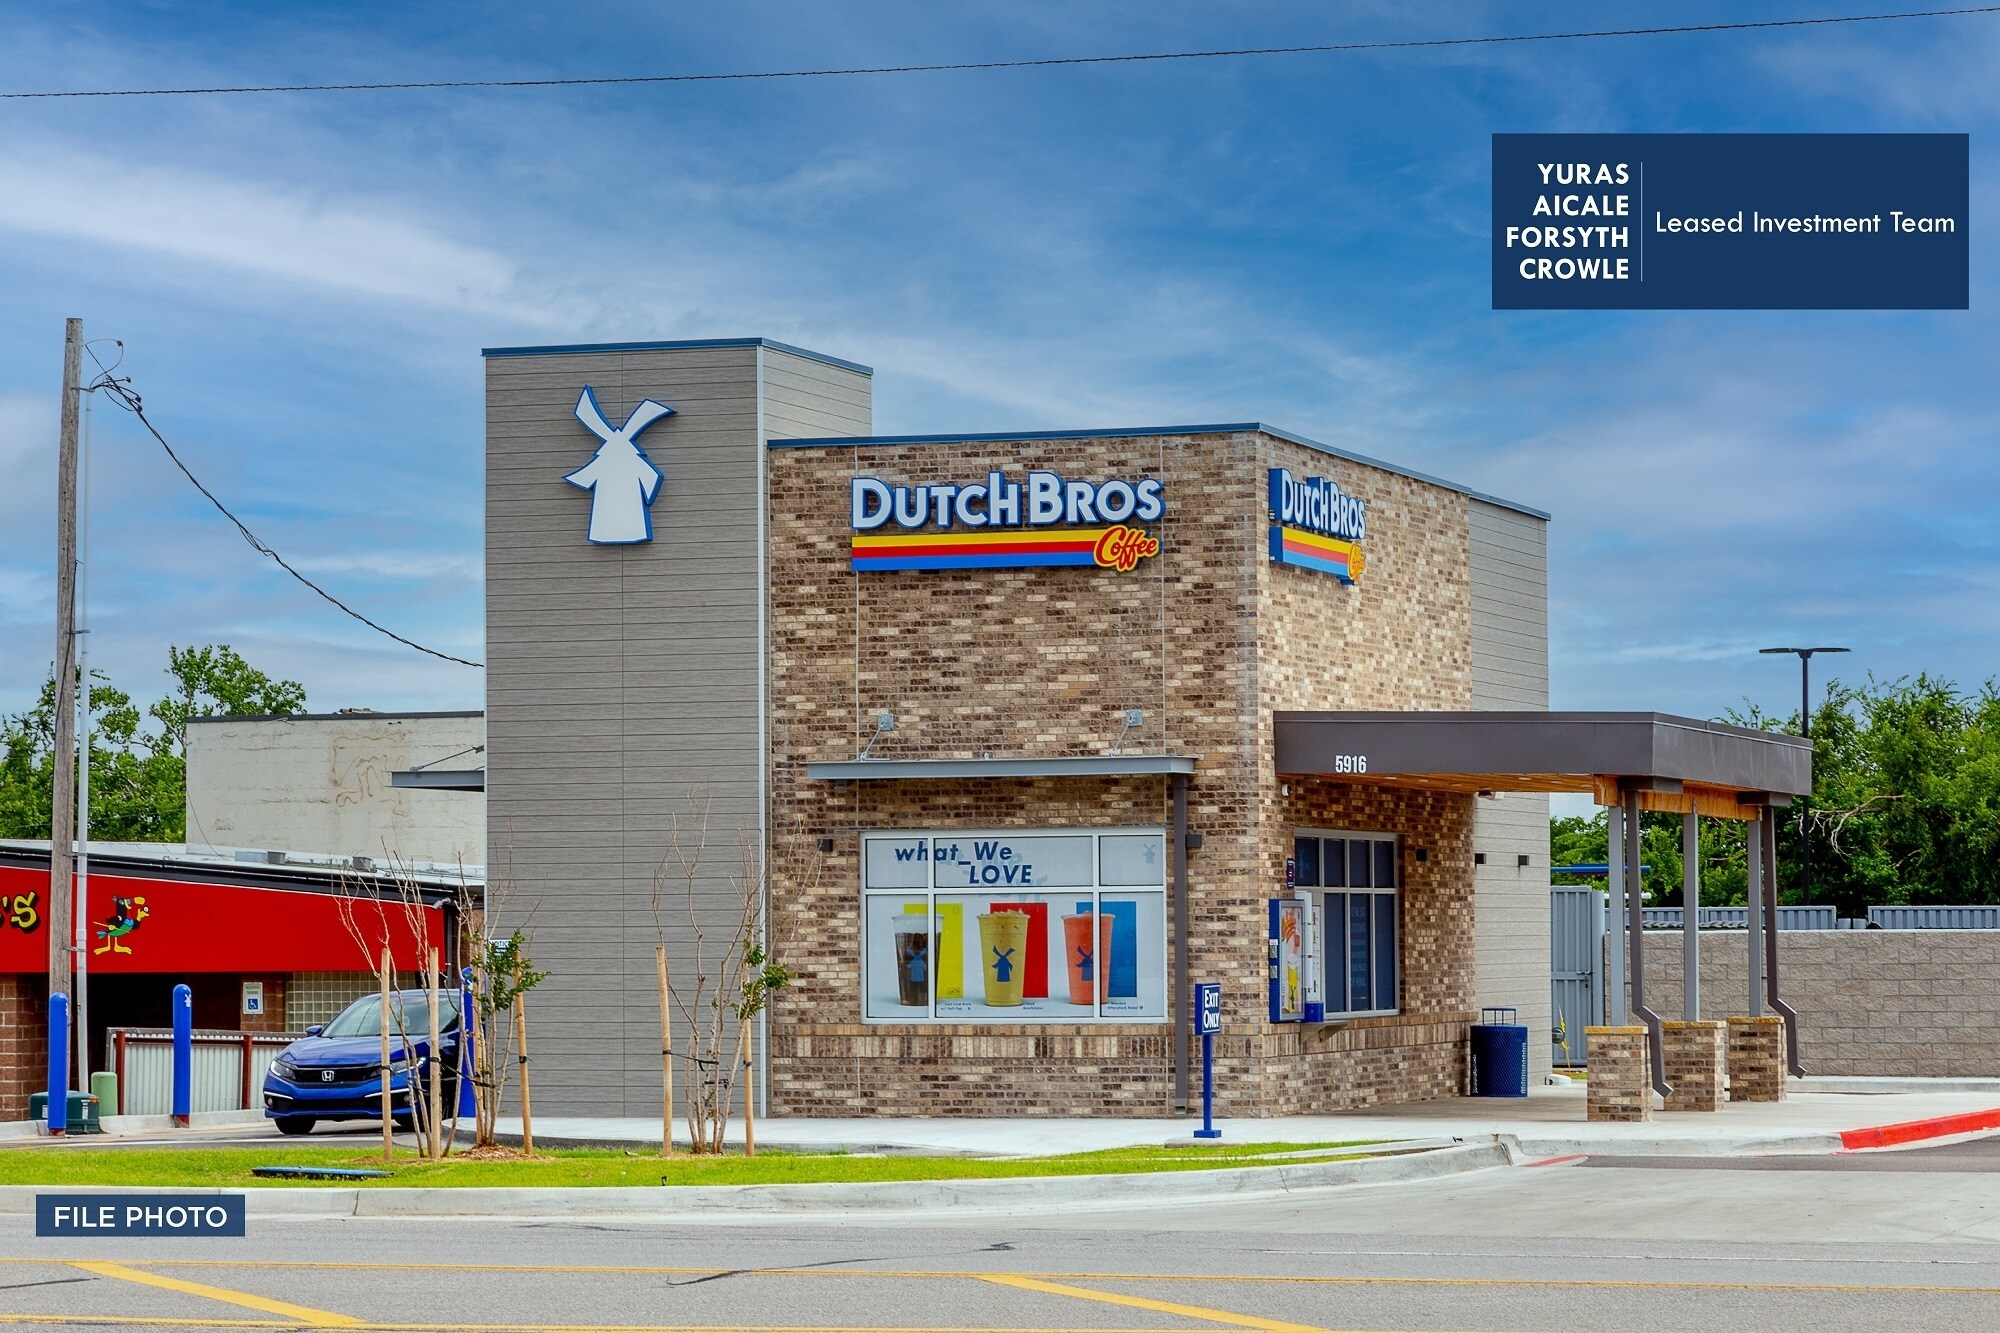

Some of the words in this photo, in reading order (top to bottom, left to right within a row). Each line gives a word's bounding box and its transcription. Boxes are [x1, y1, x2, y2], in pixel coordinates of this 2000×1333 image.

[1094, 526, 1159, 571] Coffee
[1335, 755, 1367, 773] 5916
[969, 864, 1033, 884] LOVE
